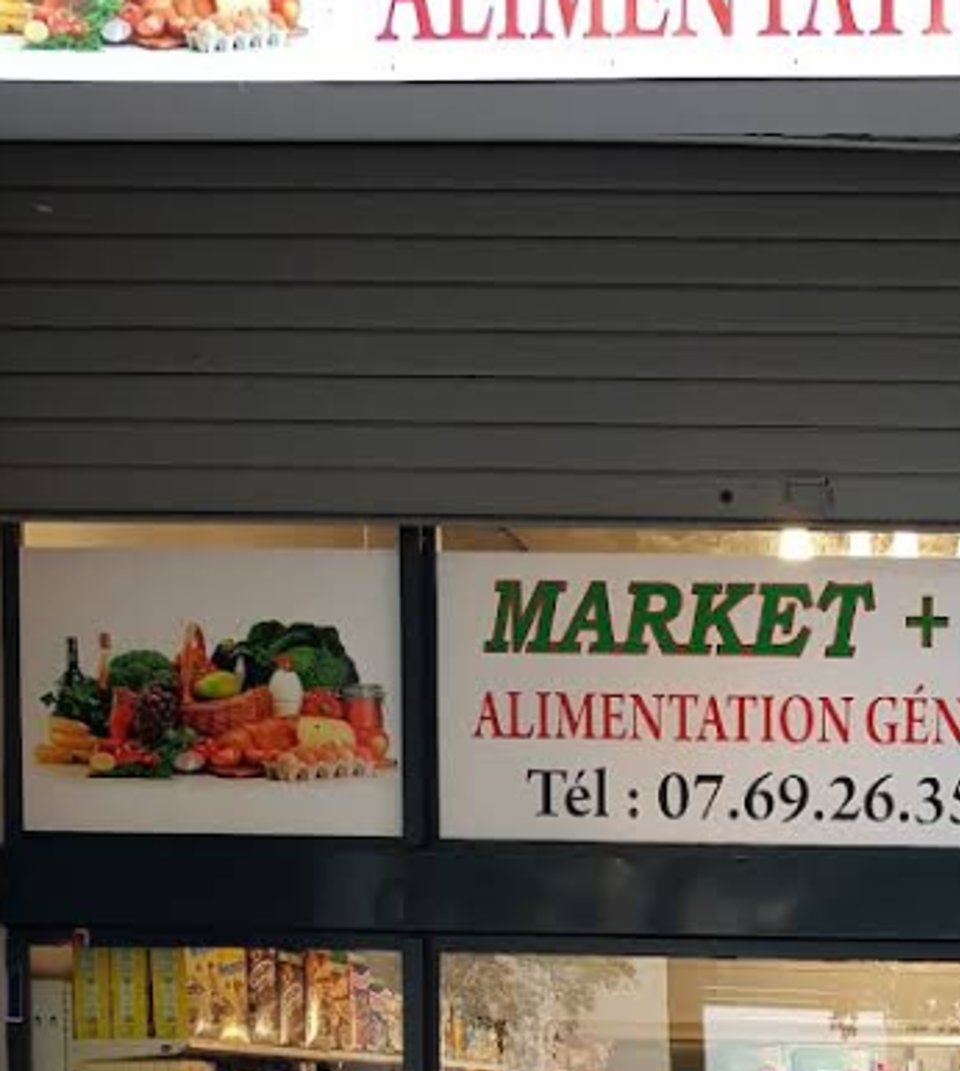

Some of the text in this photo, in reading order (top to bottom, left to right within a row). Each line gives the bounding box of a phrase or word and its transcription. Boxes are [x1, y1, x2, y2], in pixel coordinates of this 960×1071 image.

[482, 578, 876, 660] MARKET
[904, 594, 951, 649] +
[473, 690, 852, 745] ALIMENTATION
[526, 767, 609, 818] Tél
